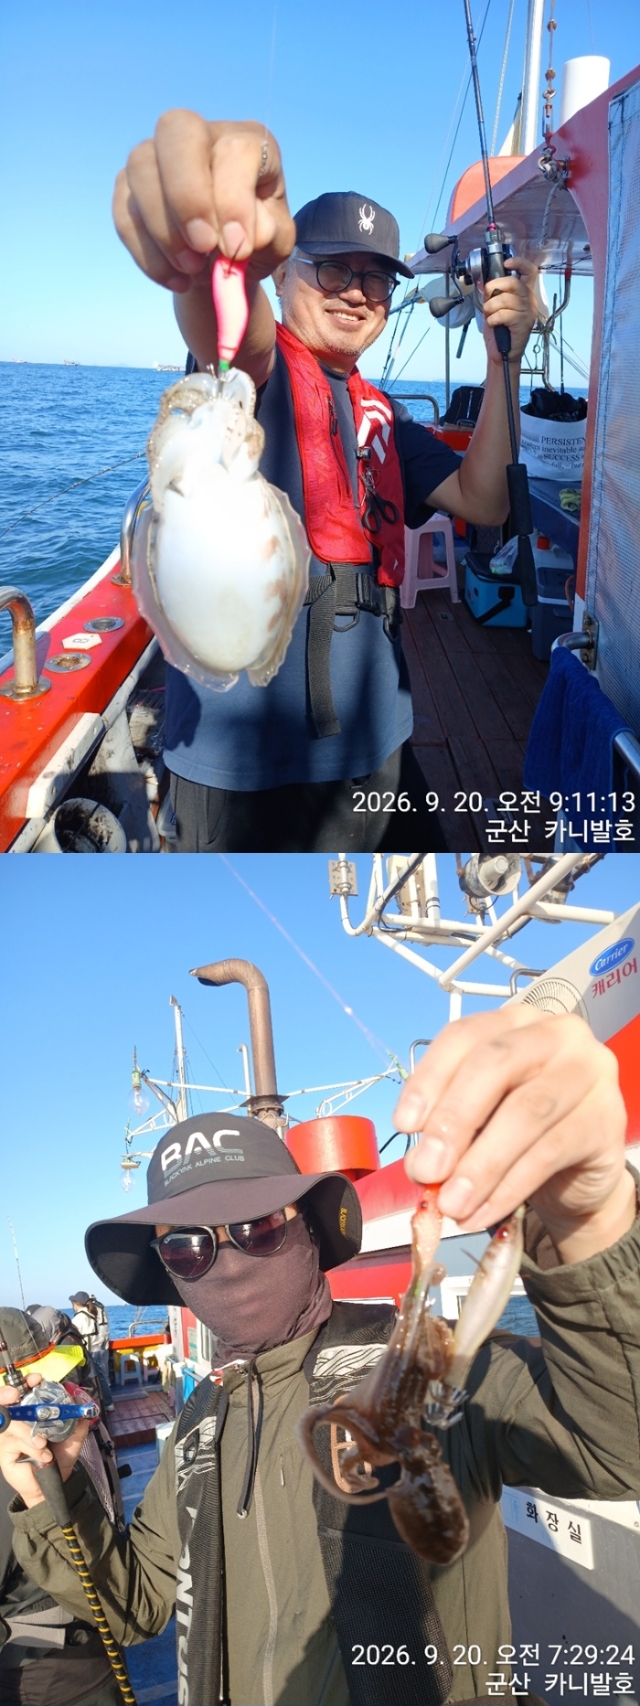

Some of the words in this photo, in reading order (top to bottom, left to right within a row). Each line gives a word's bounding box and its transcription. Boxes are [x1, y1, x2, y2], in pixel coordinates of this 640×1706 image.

[543, 453, 580, 461] SUCCESS
[594, 943, 628, 972] Carrier
[591, 957, 639, 1000] 캐리어
[161, 1129, 245, 1179] BAC
[195, 1155, 222, 1168] ALPINE
[224, 1154, 245, 1162] CLUB
[525, 1501, 582, 1545] 화장실
